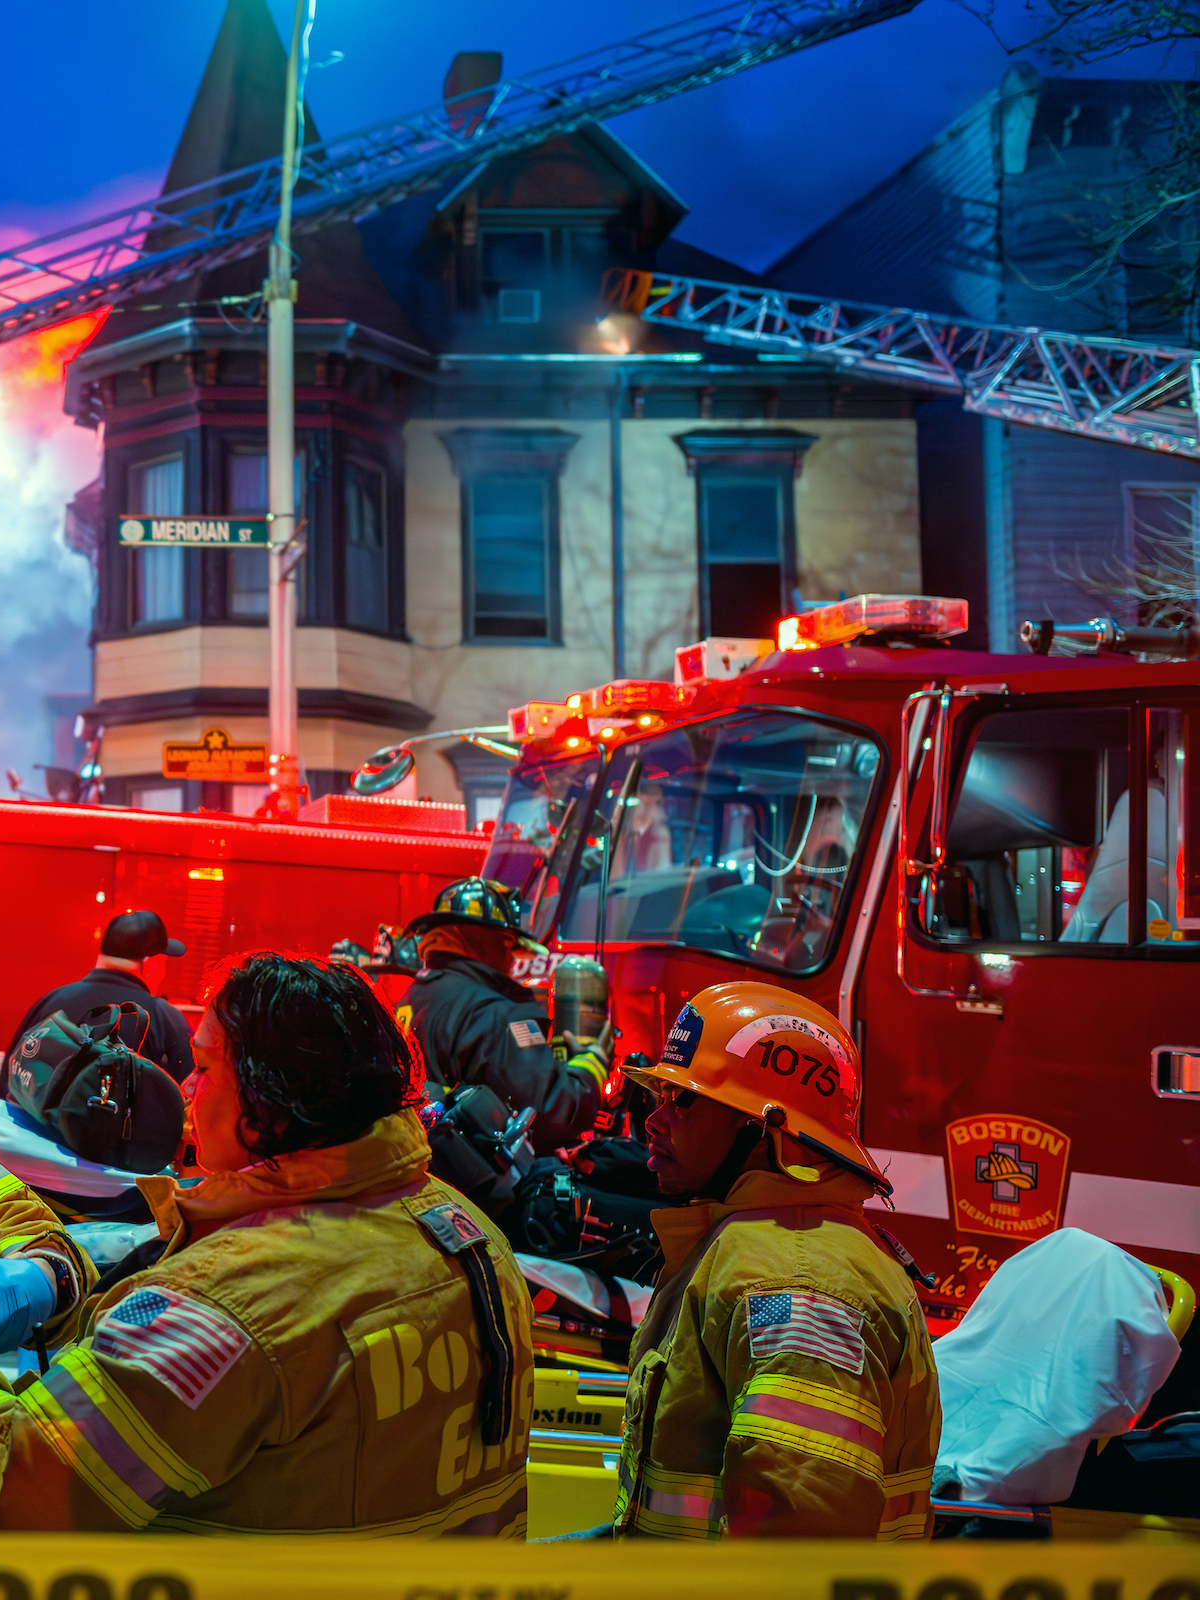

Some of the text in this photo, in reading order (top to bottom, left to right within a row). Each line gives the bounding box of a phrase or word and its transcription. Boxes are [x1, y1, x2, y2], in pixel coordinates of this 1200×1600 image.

[151, 520, 253, 542] MERIDIAN ST
[758, 1040, 841, 1097] 1075
[951, 1120, 1065, 1156] BOSTON
[957, 1198, 1055, 1231] DEPARTMENT
[989, 1203, 1020, 1217] FIRE
